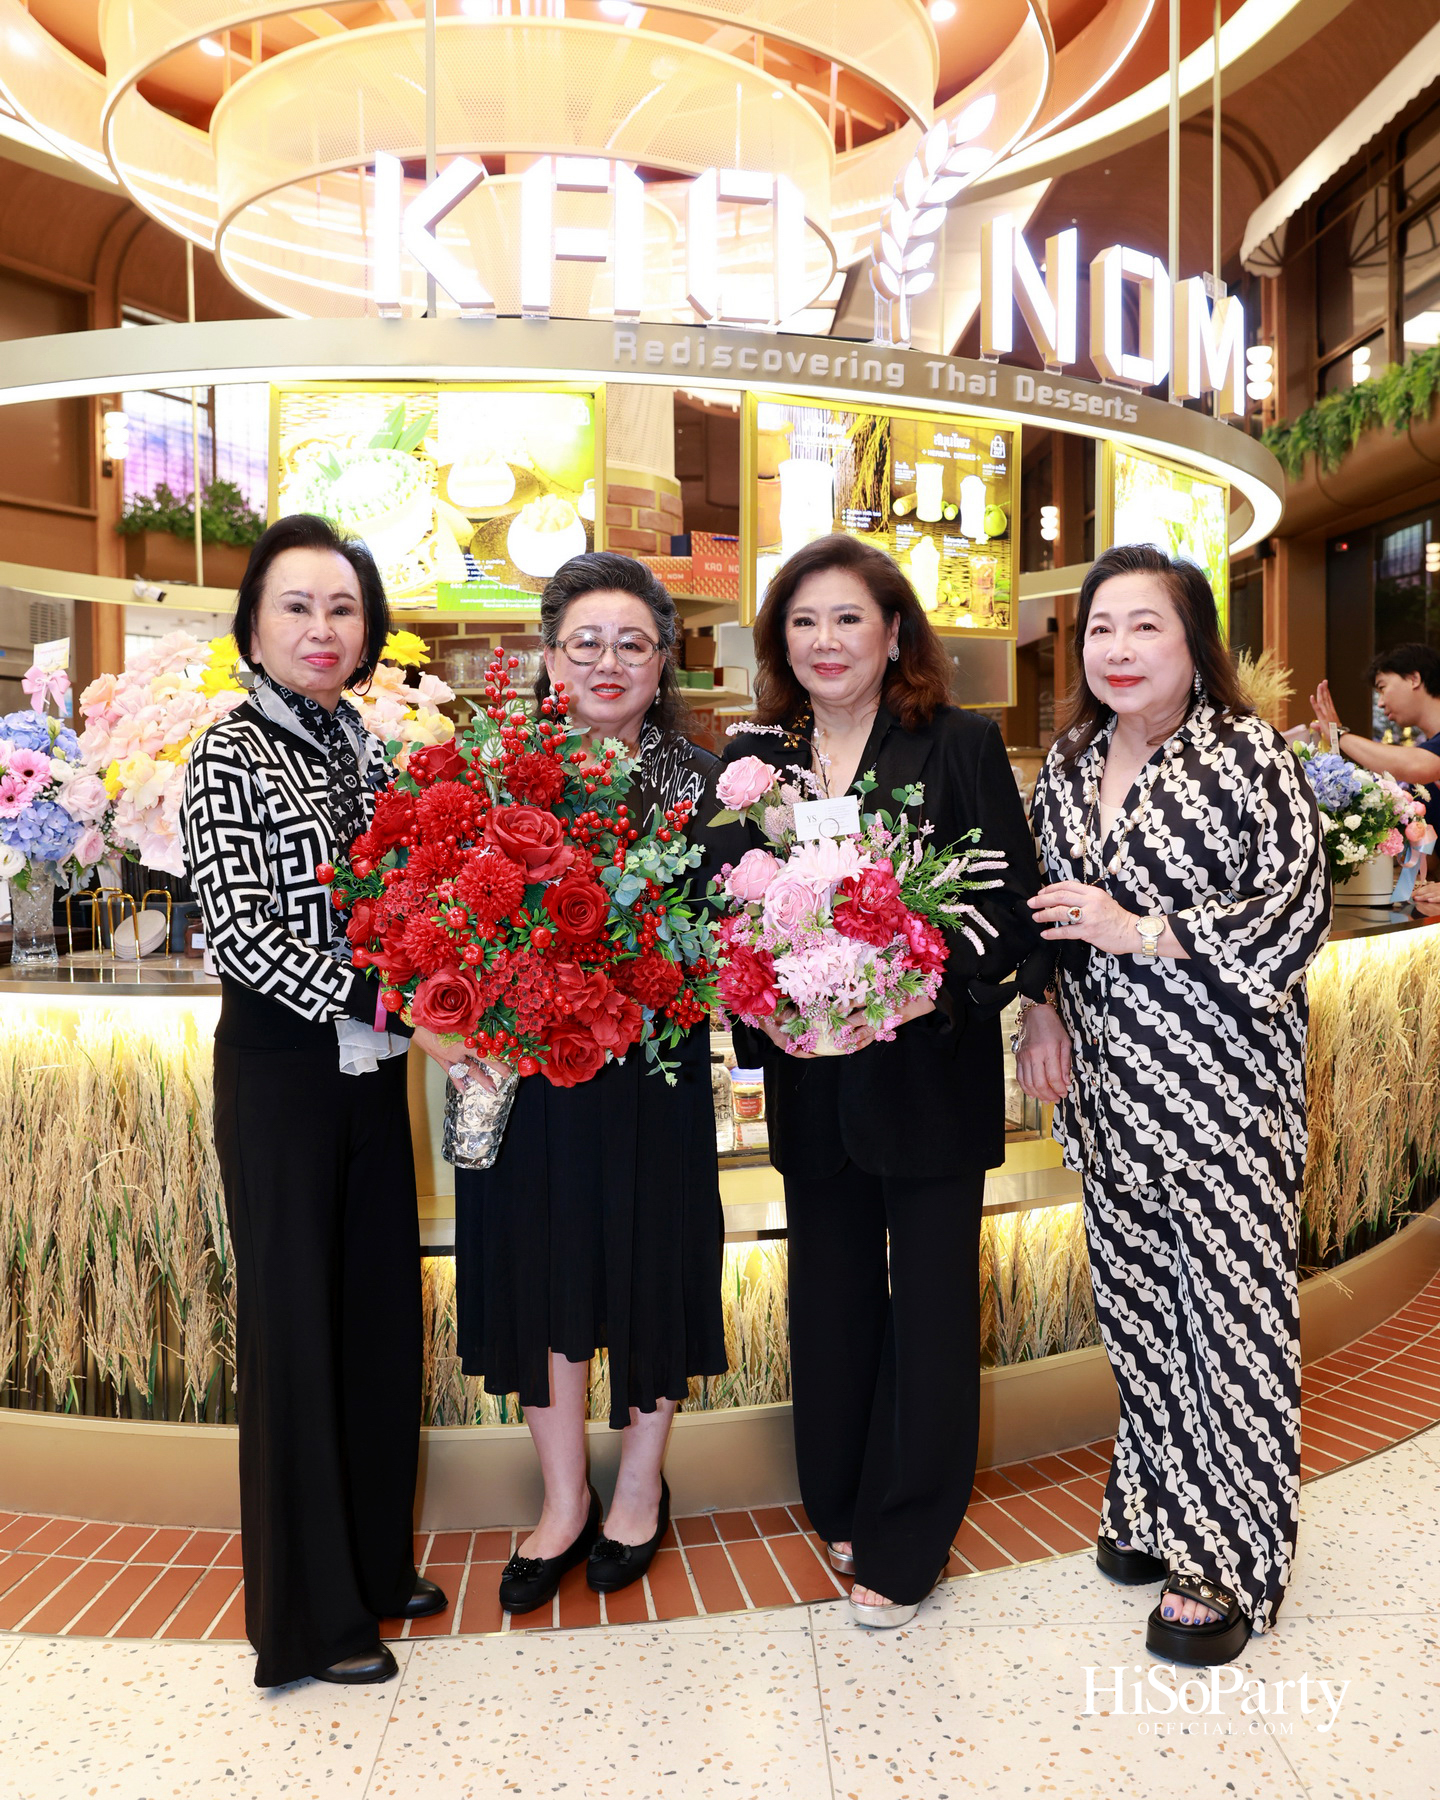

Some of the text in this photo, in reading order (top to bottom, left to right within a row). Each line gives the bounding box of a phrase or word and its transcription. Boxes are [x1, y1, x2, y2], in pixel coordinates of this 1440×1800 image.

[374, 150, 1245, 418] KAO NOM
[613, 331, 1139, 423] Rediscovering Thai Desserts
[927, 449, 951, 458] HERBAL
[704, 562, 723, 573] KAO
